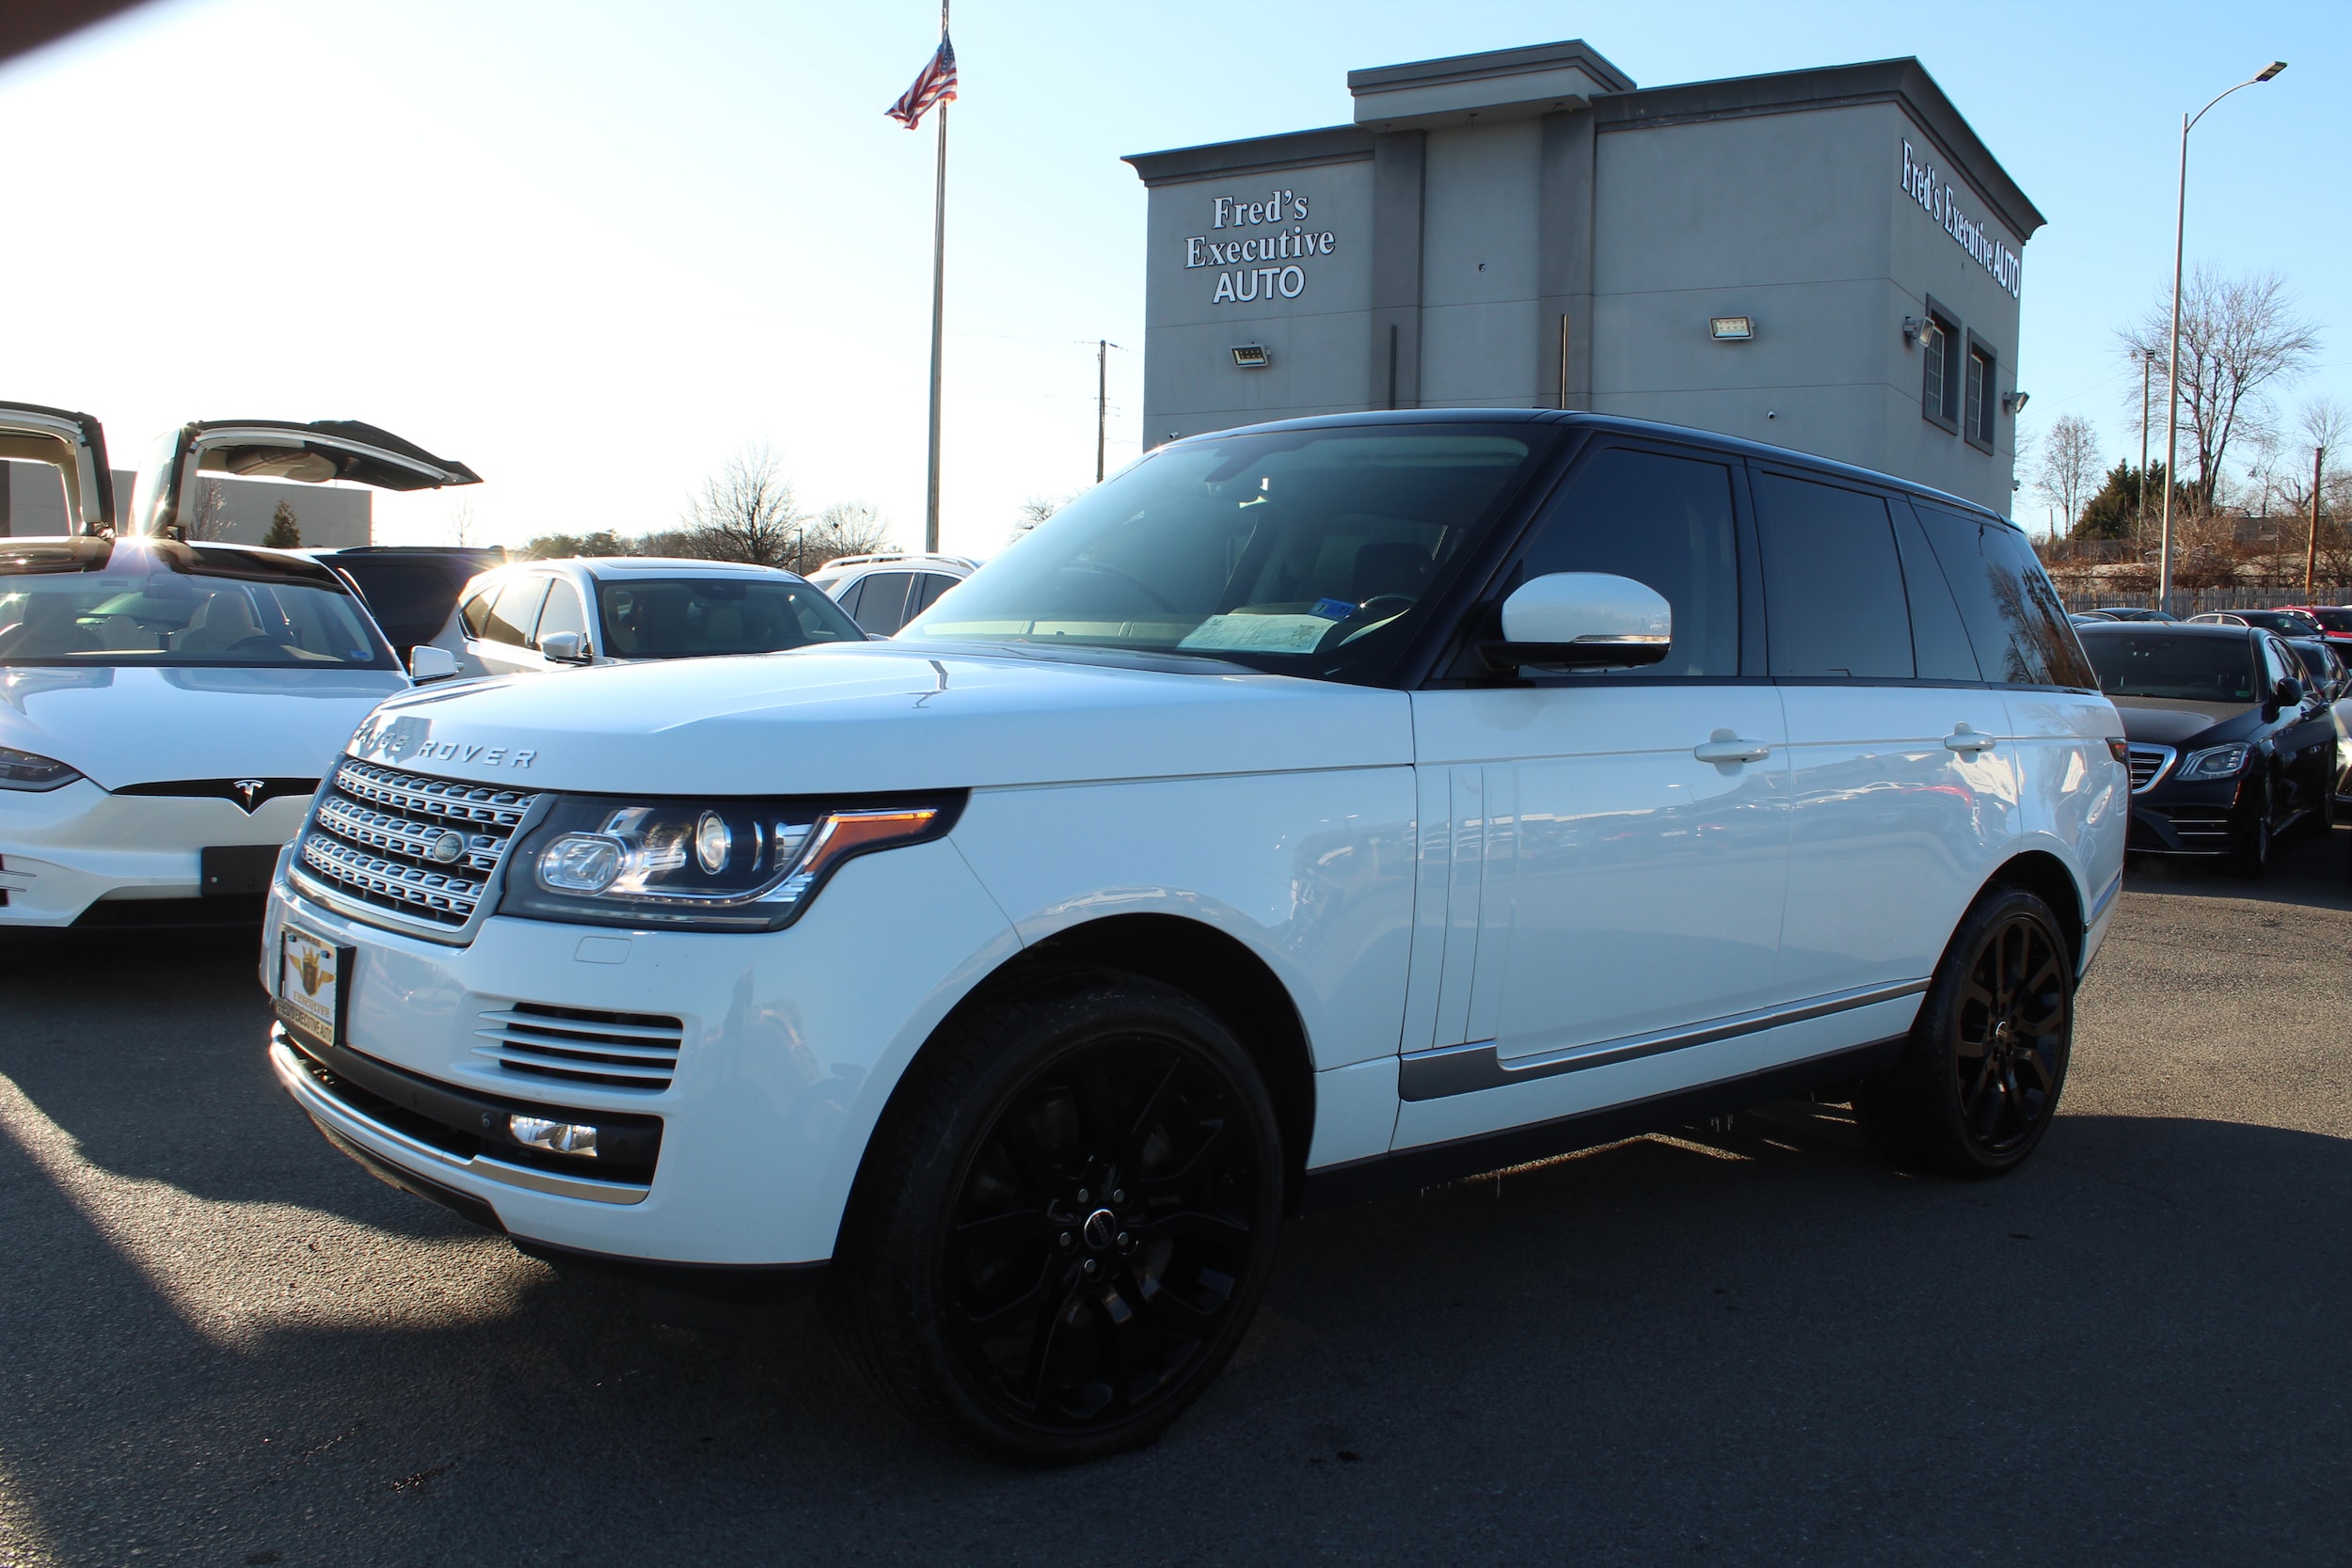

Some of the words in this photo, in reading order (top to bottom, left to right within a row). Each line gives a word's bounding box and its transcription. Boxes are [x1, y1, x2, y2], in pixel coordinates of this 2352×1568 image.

[1211, 189, 1309, 230] Fred's
[1901, 137, 1941, 222] Fred's
[1944, 182, 1993, 273] Executive
[1992, 240, 2020, 299] AUTO
[1184, 226, 1335, 269] Executive
[1212, 265, 1305, 304] AUTO
[353, 723, 410, 752] RANGE
[417, 740, 538, 768] ROVER
